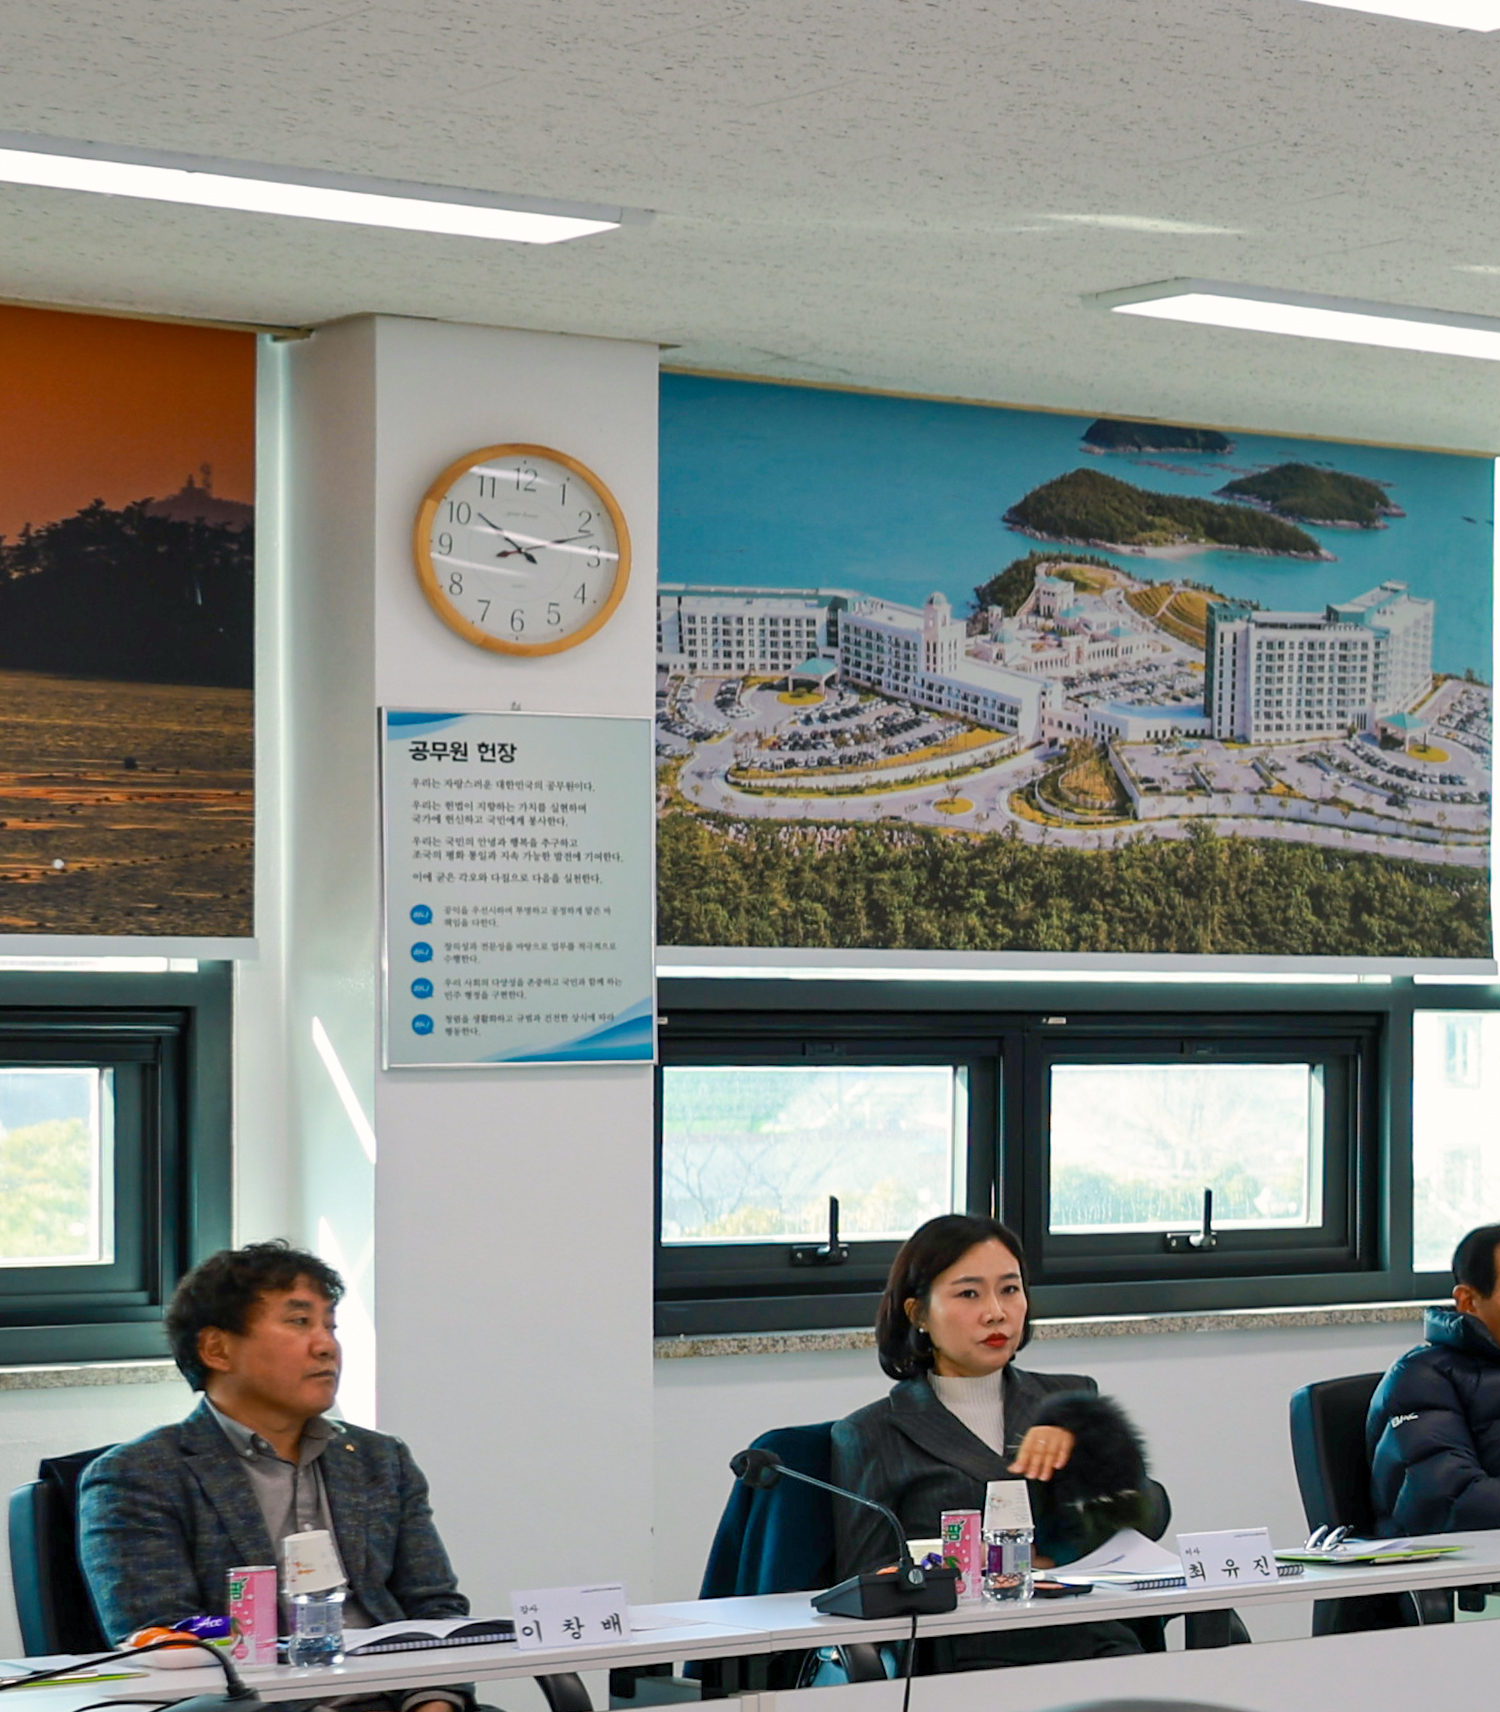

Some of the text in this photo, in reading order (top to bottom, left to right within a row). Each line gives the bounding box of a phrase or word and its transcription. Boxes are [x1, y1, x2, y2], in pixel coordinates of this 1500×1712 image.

[478, 475, 496, 499] 11
[514, 467, 538, 492] 12
[559, 482, 567, 506] 1
[448, 501, 472, 526] 10
[578, 510, 593, 534] 2
[438, 532, 453, 556] 9
[587, 545, 601, 569] 3
[449, 572, 464, 596] 8
[573, 582, 587, 605] 4
[477, 599, 491, 622] 7
[510, 608, 525, 633] 6
[547, 603, 561, 626] 5
[408, 740, 517, 764] 공무원 헌장
